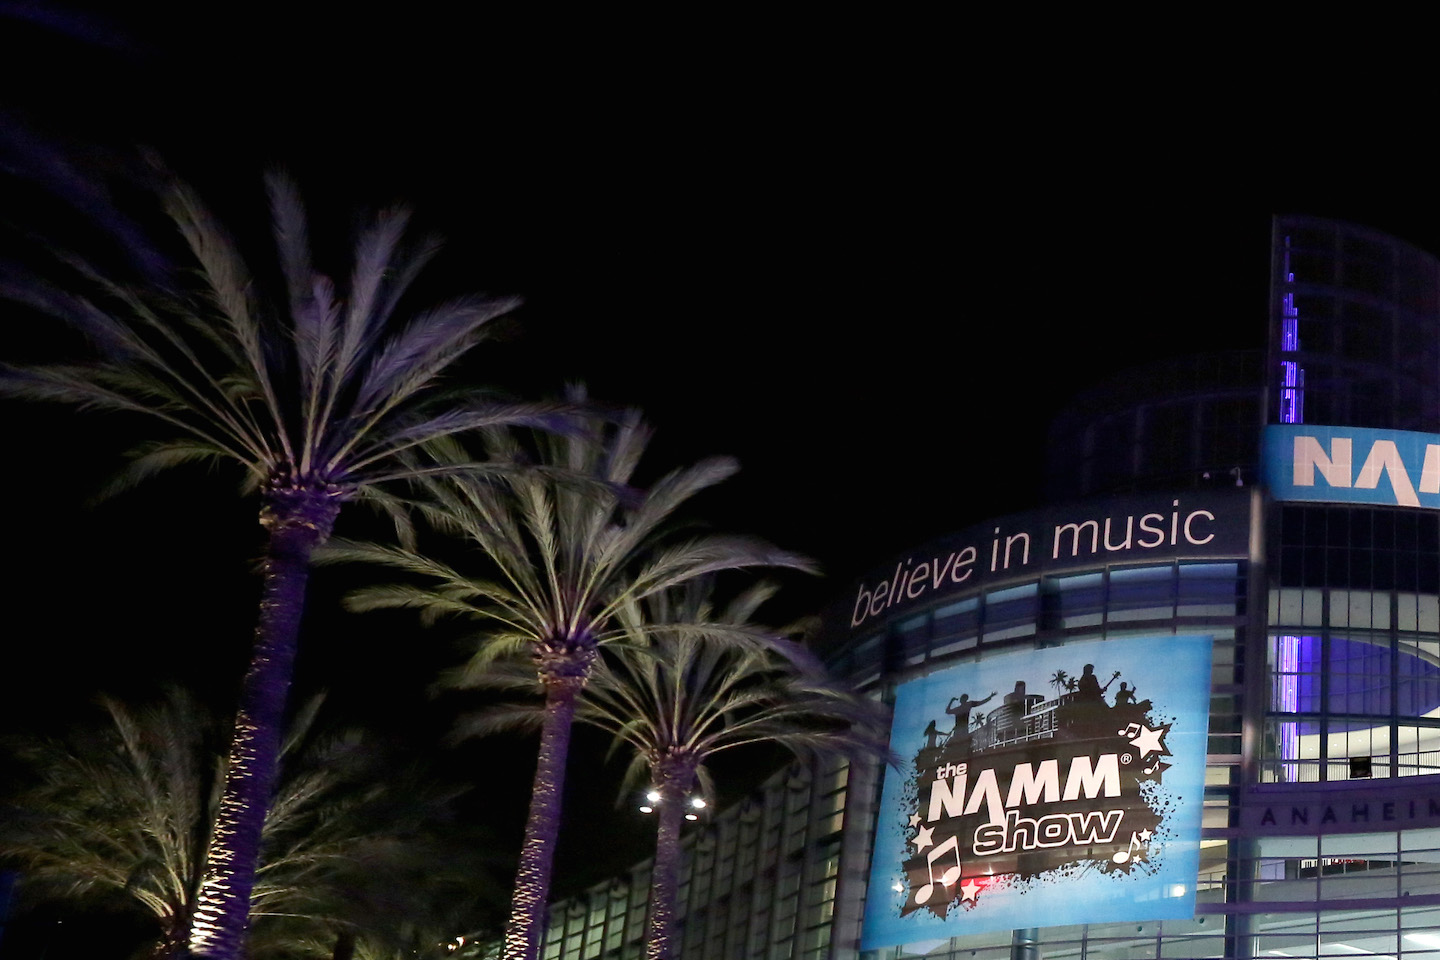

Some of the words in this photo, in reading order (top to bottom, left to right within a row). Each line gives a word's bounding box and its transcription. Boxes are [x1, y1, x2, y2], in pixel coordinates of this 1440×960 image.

[850, 543, 977, 628] believe
[989, 527, 1030, 572] in
[1052, 500, 1216, 559] music
[936, 762, 967, 780] the
[973, 810, 1124, 856] show
